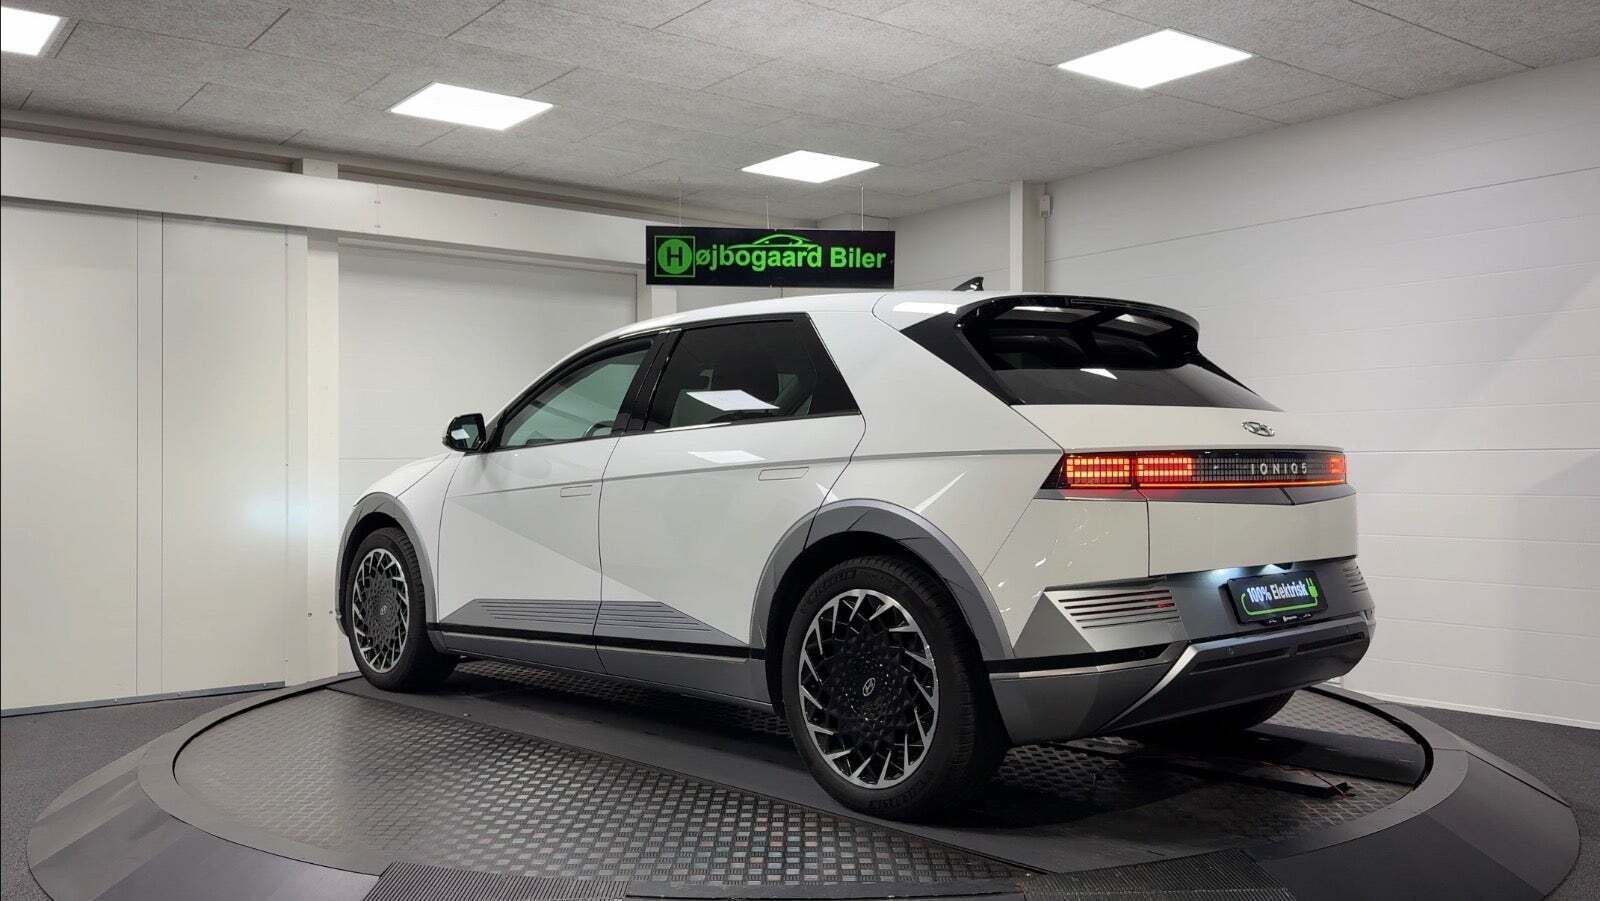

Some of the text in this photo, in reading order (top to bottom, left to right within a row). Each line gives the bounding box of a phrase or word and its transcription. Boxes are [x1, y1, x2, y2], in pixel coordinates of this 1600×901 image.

[830, 247, 887, 269] Biler
[1246, 580, 1309, 603] 100% Elektrisk
